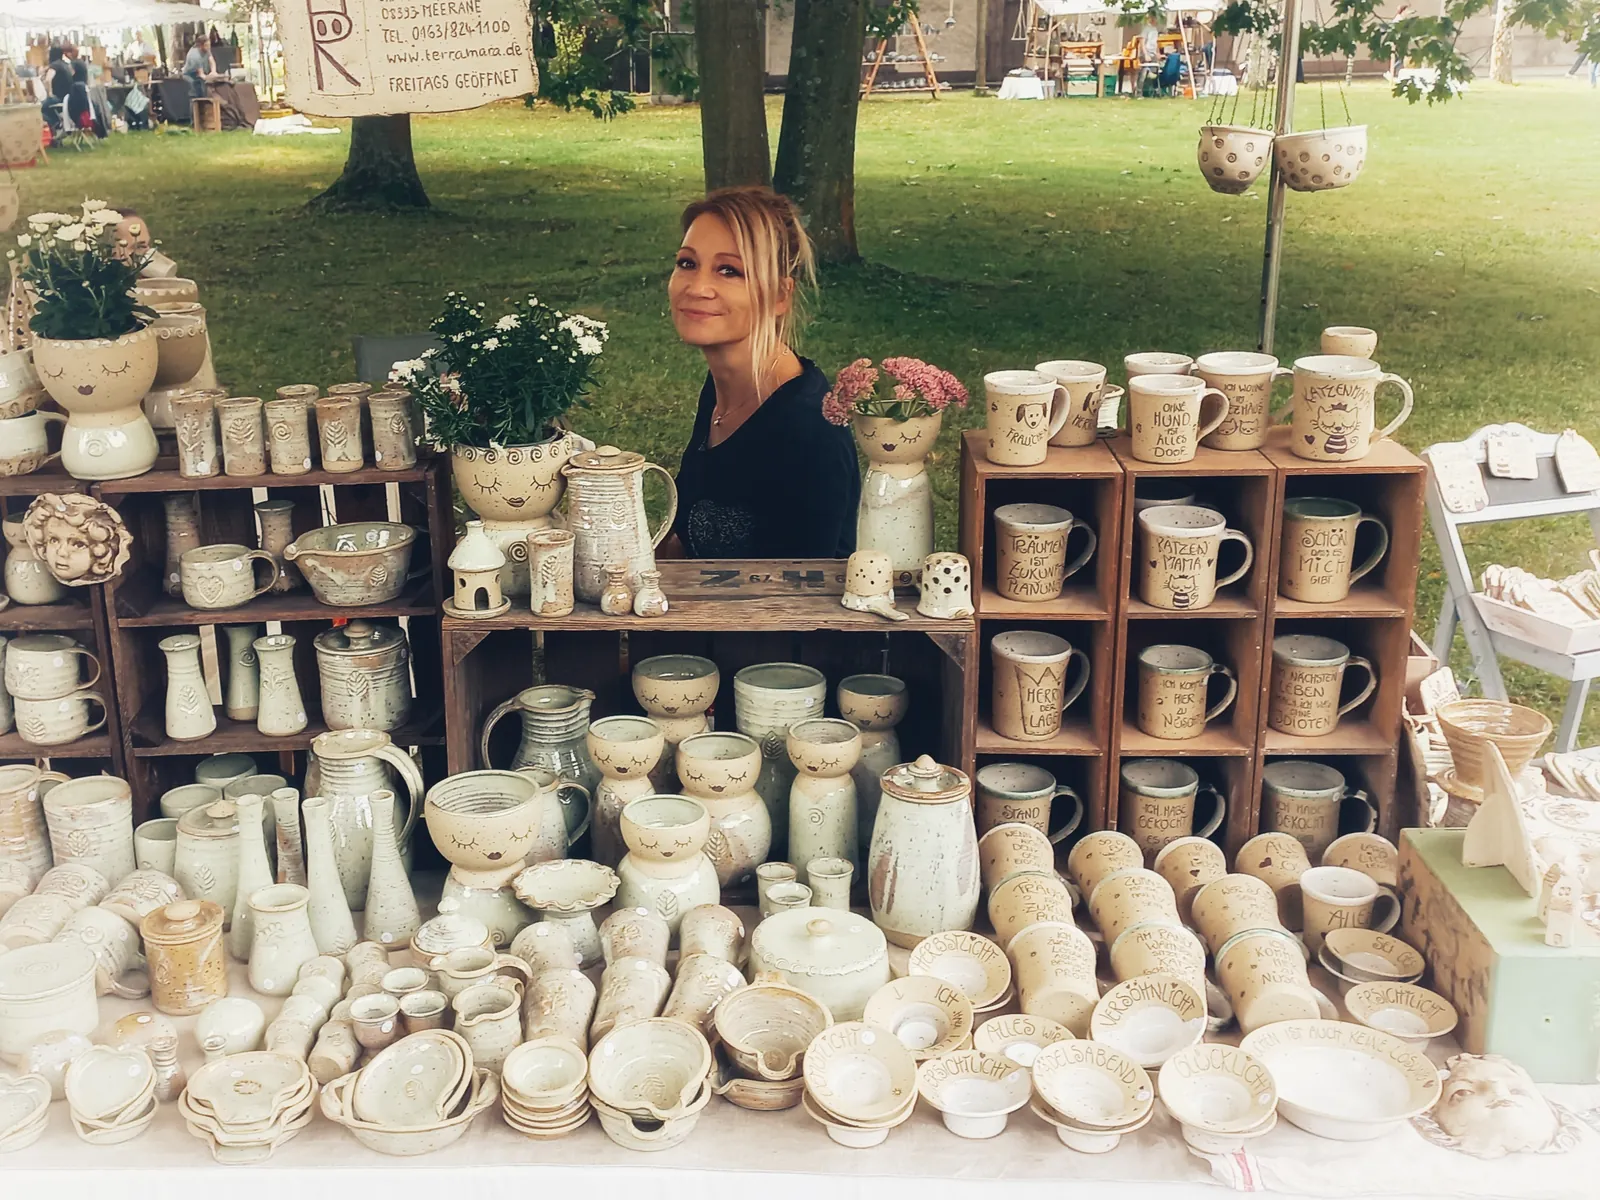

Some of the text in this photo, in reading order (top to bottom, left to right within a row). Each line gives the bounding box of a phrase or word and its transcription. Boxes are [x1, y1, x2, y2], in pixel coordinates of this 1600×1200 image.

[421, 1, 482, 18] MEERANE
[381, 28, 408, 43] TEL.
[389, 69, 519, 92] FREITAGS GEÖFFNET
[1163, 402, 1187, 413] OHNE
[1154, 411, 1191, 428] HUND
[1156, 435, 1188, 446] ALLES
[1030, 556, 1049, 566] IST
[1163, 555, 1202, 572] MAMA
[1299, 556, 1346, 574] MICH
[1290, 670, 1338, 684] NÄCHSTEN
[1002, 804, 1041, 820] STAND
[1138, 815, 1188, 830] GEKOCHT
[912, 932, 1000, 972] HERBSTLICHT
[934, 984, 960, 1007] ICH
[1098, 980, 1195, 1026] VERSÖHNLICHT
[987, 1018, 1036, 1043] ALLES
[1309, 1026, 1343, 1041] AUCH
[1350, 1031, 1388, 1053] KEINE
[1173, 1048, 1272, 1096] GLÜCKLICHT
